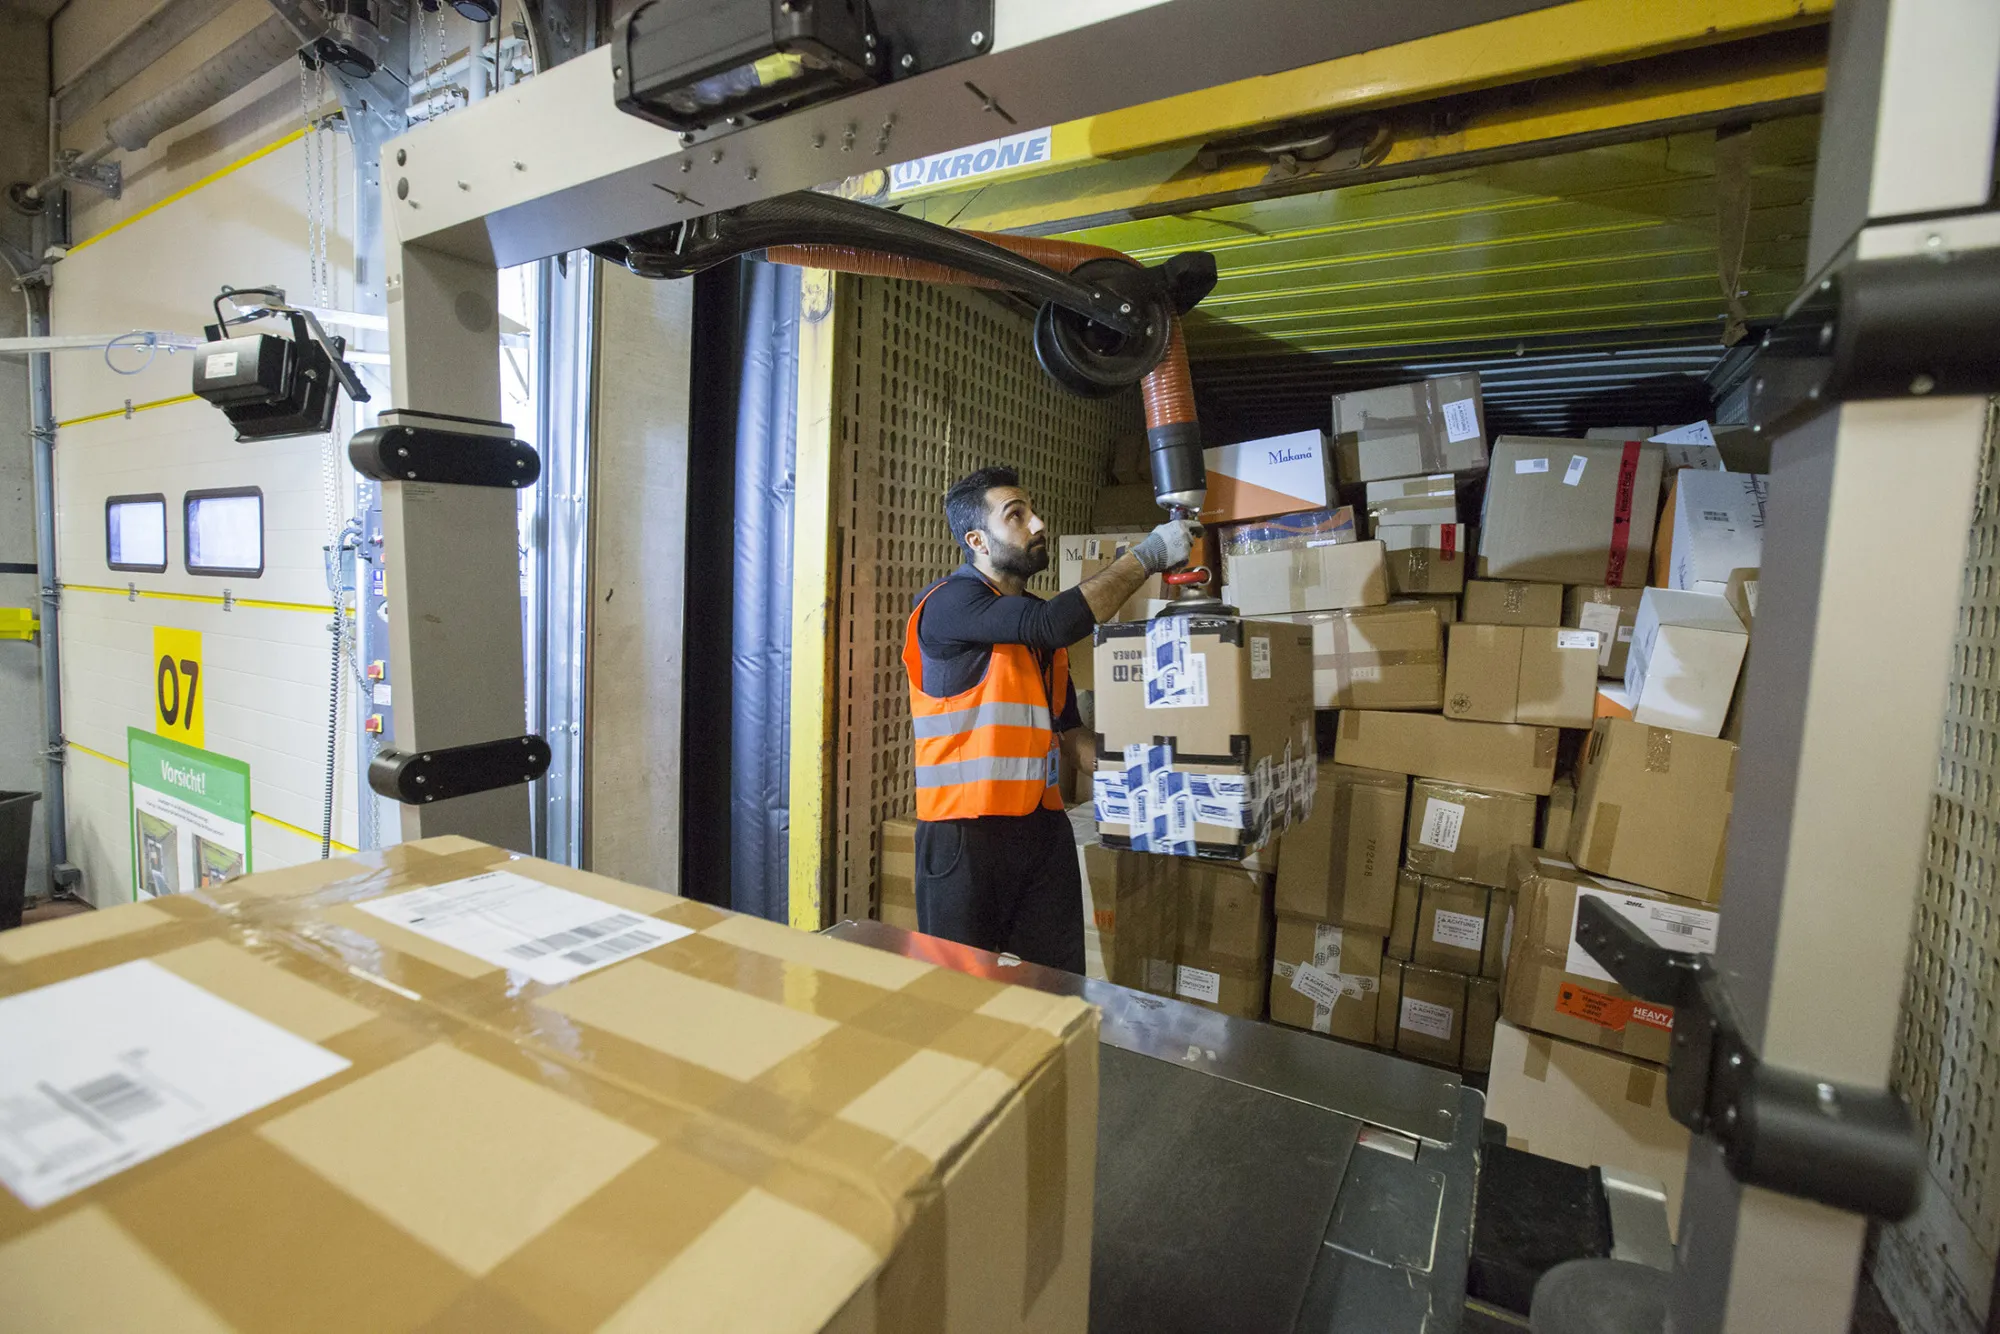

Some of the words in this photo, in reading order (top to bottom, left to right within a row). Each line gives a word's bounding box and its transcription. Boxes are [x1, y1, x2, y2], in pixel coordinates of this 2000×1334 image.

[926, 136, 1048, 184] KRONE
[1268, 448, 1312, 465] Makana
[158, 654, 199, 731] 07
[160, 759, 206, 796] Vorsicht!
[1435, 811, 1445, 838] ACHTUNG
[1624, 900, 1645, 909] DHL
[1447, 918, 1477, 930] ACHTUNG
[1309, 976, 1335, 994] ACHTUNG
[1418, 1006, 1448, 1019] ACHTUNG
[1633, 1006, 1669, 1022] HEAVY
